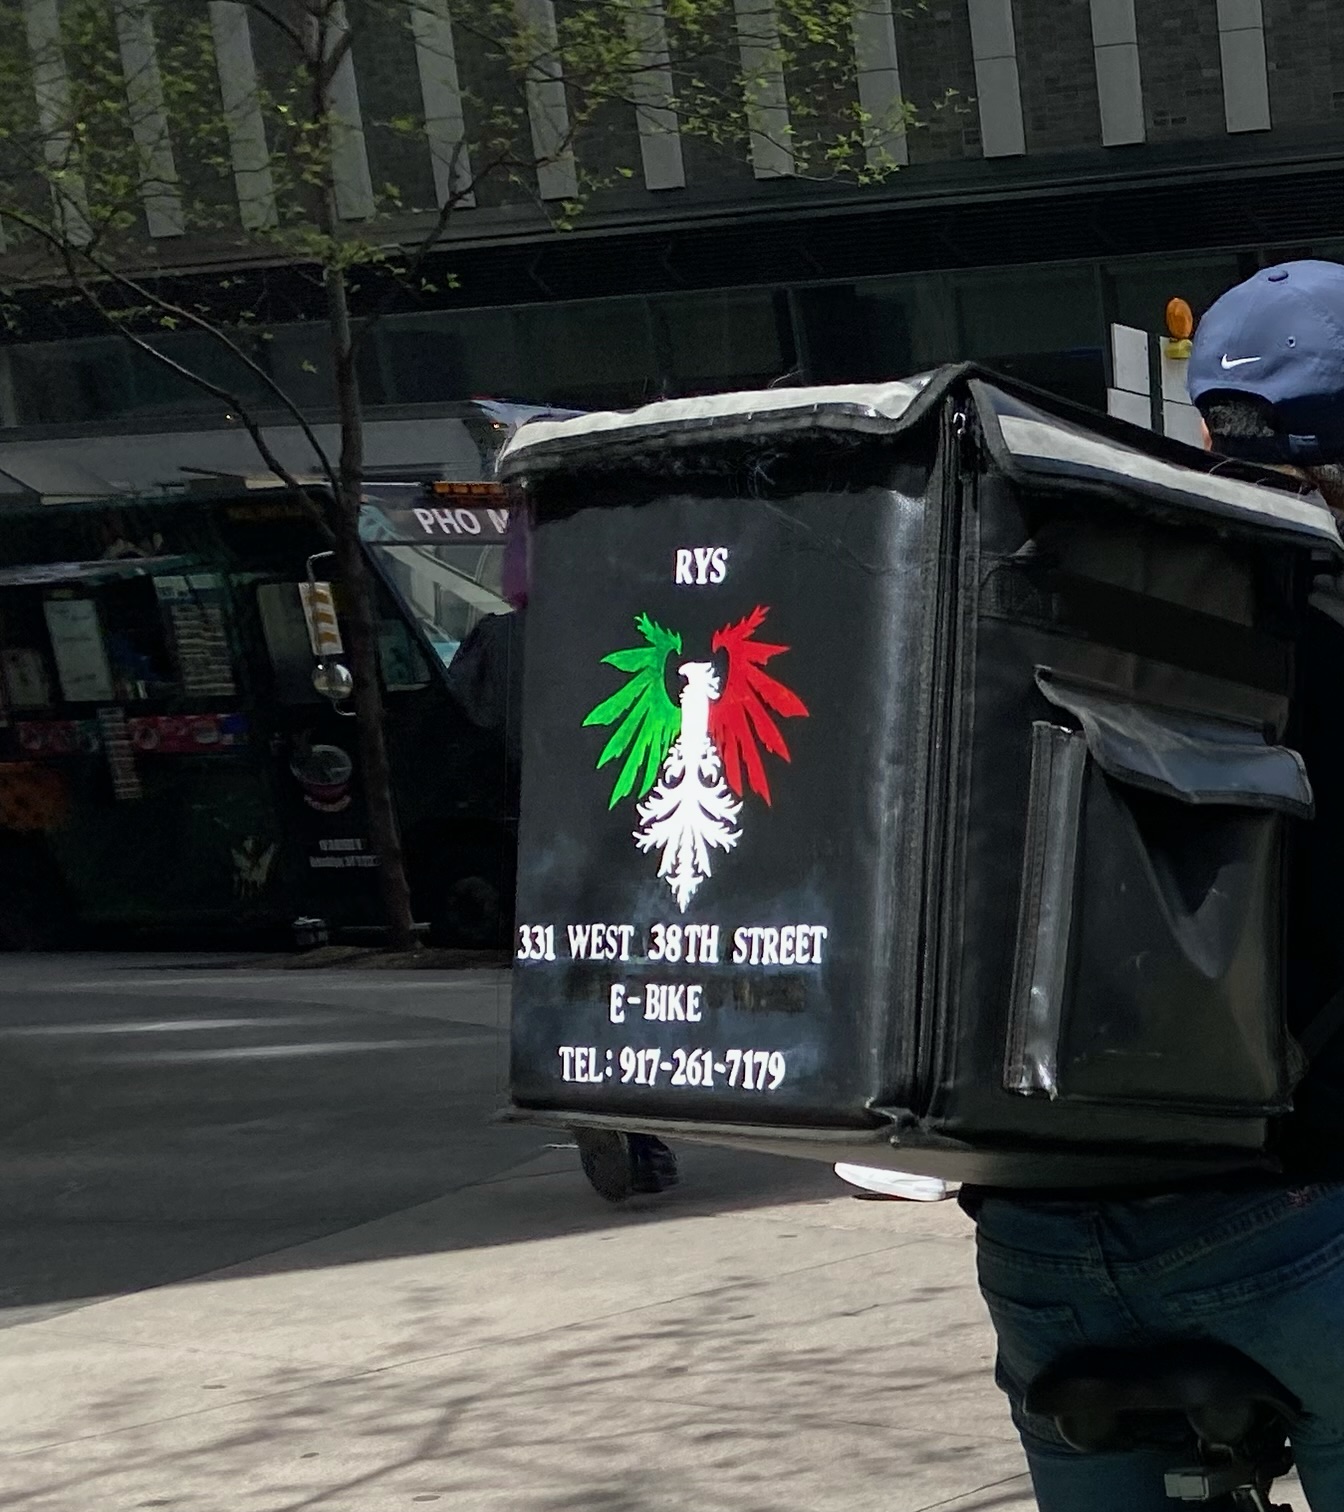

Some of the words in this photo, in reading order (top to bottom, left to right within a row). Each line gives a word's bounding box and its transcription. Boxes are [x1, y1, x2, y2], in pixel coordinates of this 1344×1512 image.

[412, 508, 481, 535] PHO
[675, 547, 728, 585] RYS
[516, 924, 557, 961] 331
[567, 923, 635, 961] WEST
[647, 923, 720, 963] 38TH
[731, 923, 828, 965] STREET
[558, 1046, 613, 1084] TEL:
[619, 1046, 787, 1091] 917-261-7179
